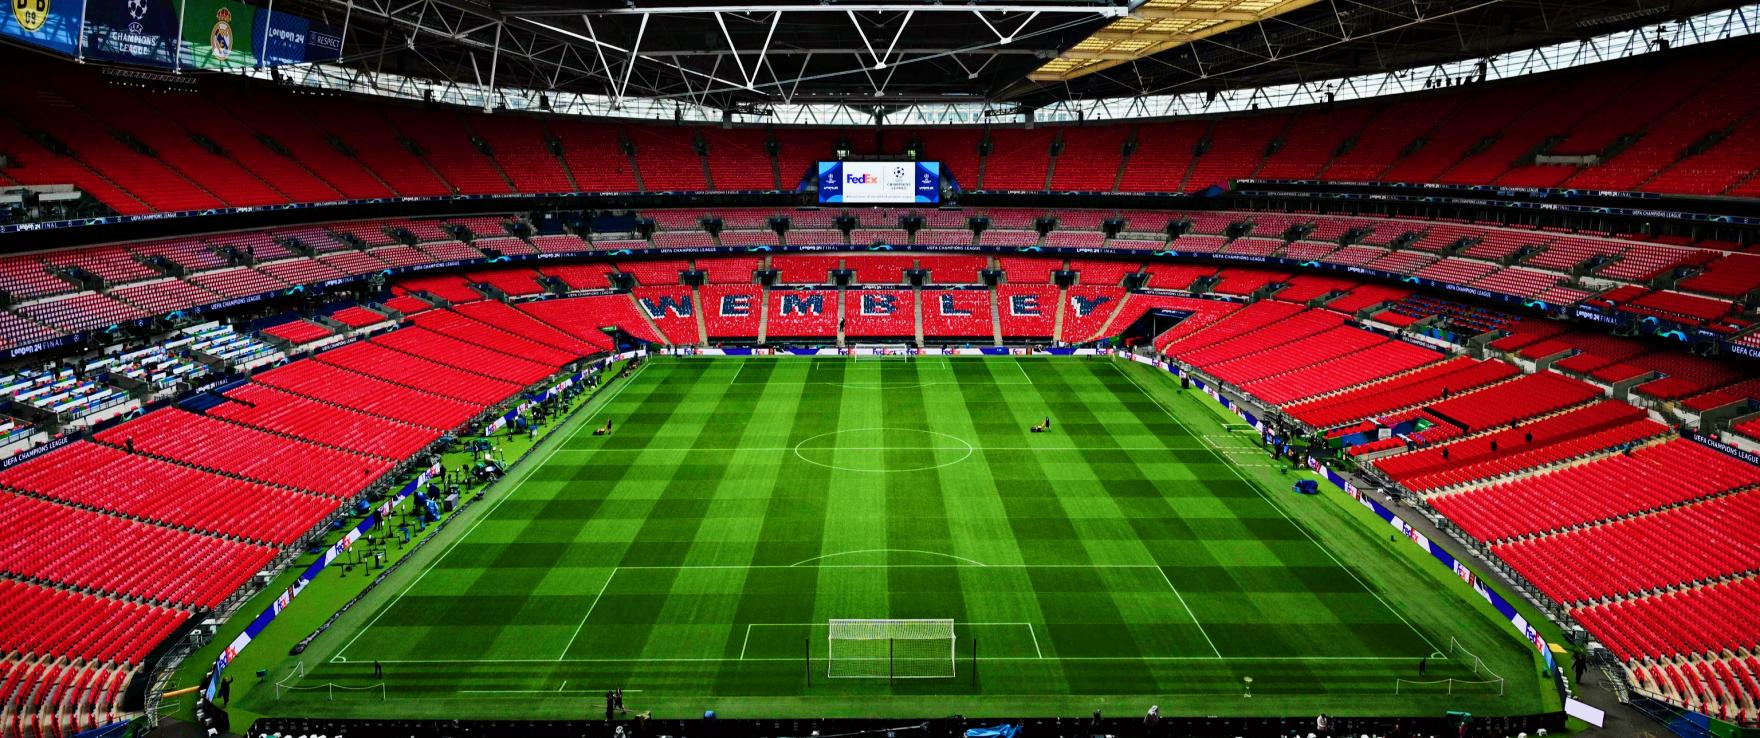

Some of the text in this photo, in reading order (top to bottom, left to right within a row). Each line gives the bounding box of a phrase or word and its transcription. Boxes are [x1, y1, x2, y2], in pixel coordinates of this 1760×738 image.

[112, 32, 156, 46] CHAMPIONS
[295, 34, 304, 44] 24
[317, 35, 340, 47] RESPECT
[120, 43, 150, 55] LEAGUE
[846, 173, 877, 184] FedEx
[211, 295, 261, 310] UEFA CHAMPIONS LEAGUE
[639, 294, 1111, 320] WEMBLEY
[1600, 315, 1617, 325] FINAL
[34, 343, 41, 352] 24
[42, 339, 63, 349] FINAL
[838, 347, 856, 355] FedEx
[906, 347, 927, 355] FedEx
[942, 347, 961, 355] FedEx
[1096, 347, 1113, 355] FedEx
[1732, 345, 1748, 356] UEFA
[4, 437, 68, 467] UEFA CHAMPIONS LEAGUE
[1694, 434, 1759, 464] UEFA CHAMPIONS LEAGUE
[1403, 522, 1419, 543] FedEx
[335, 536, 350, 555] FedEx
[1526, 623, 1543, 653] FedEx
[217, 646, 237, 669] FedEx
